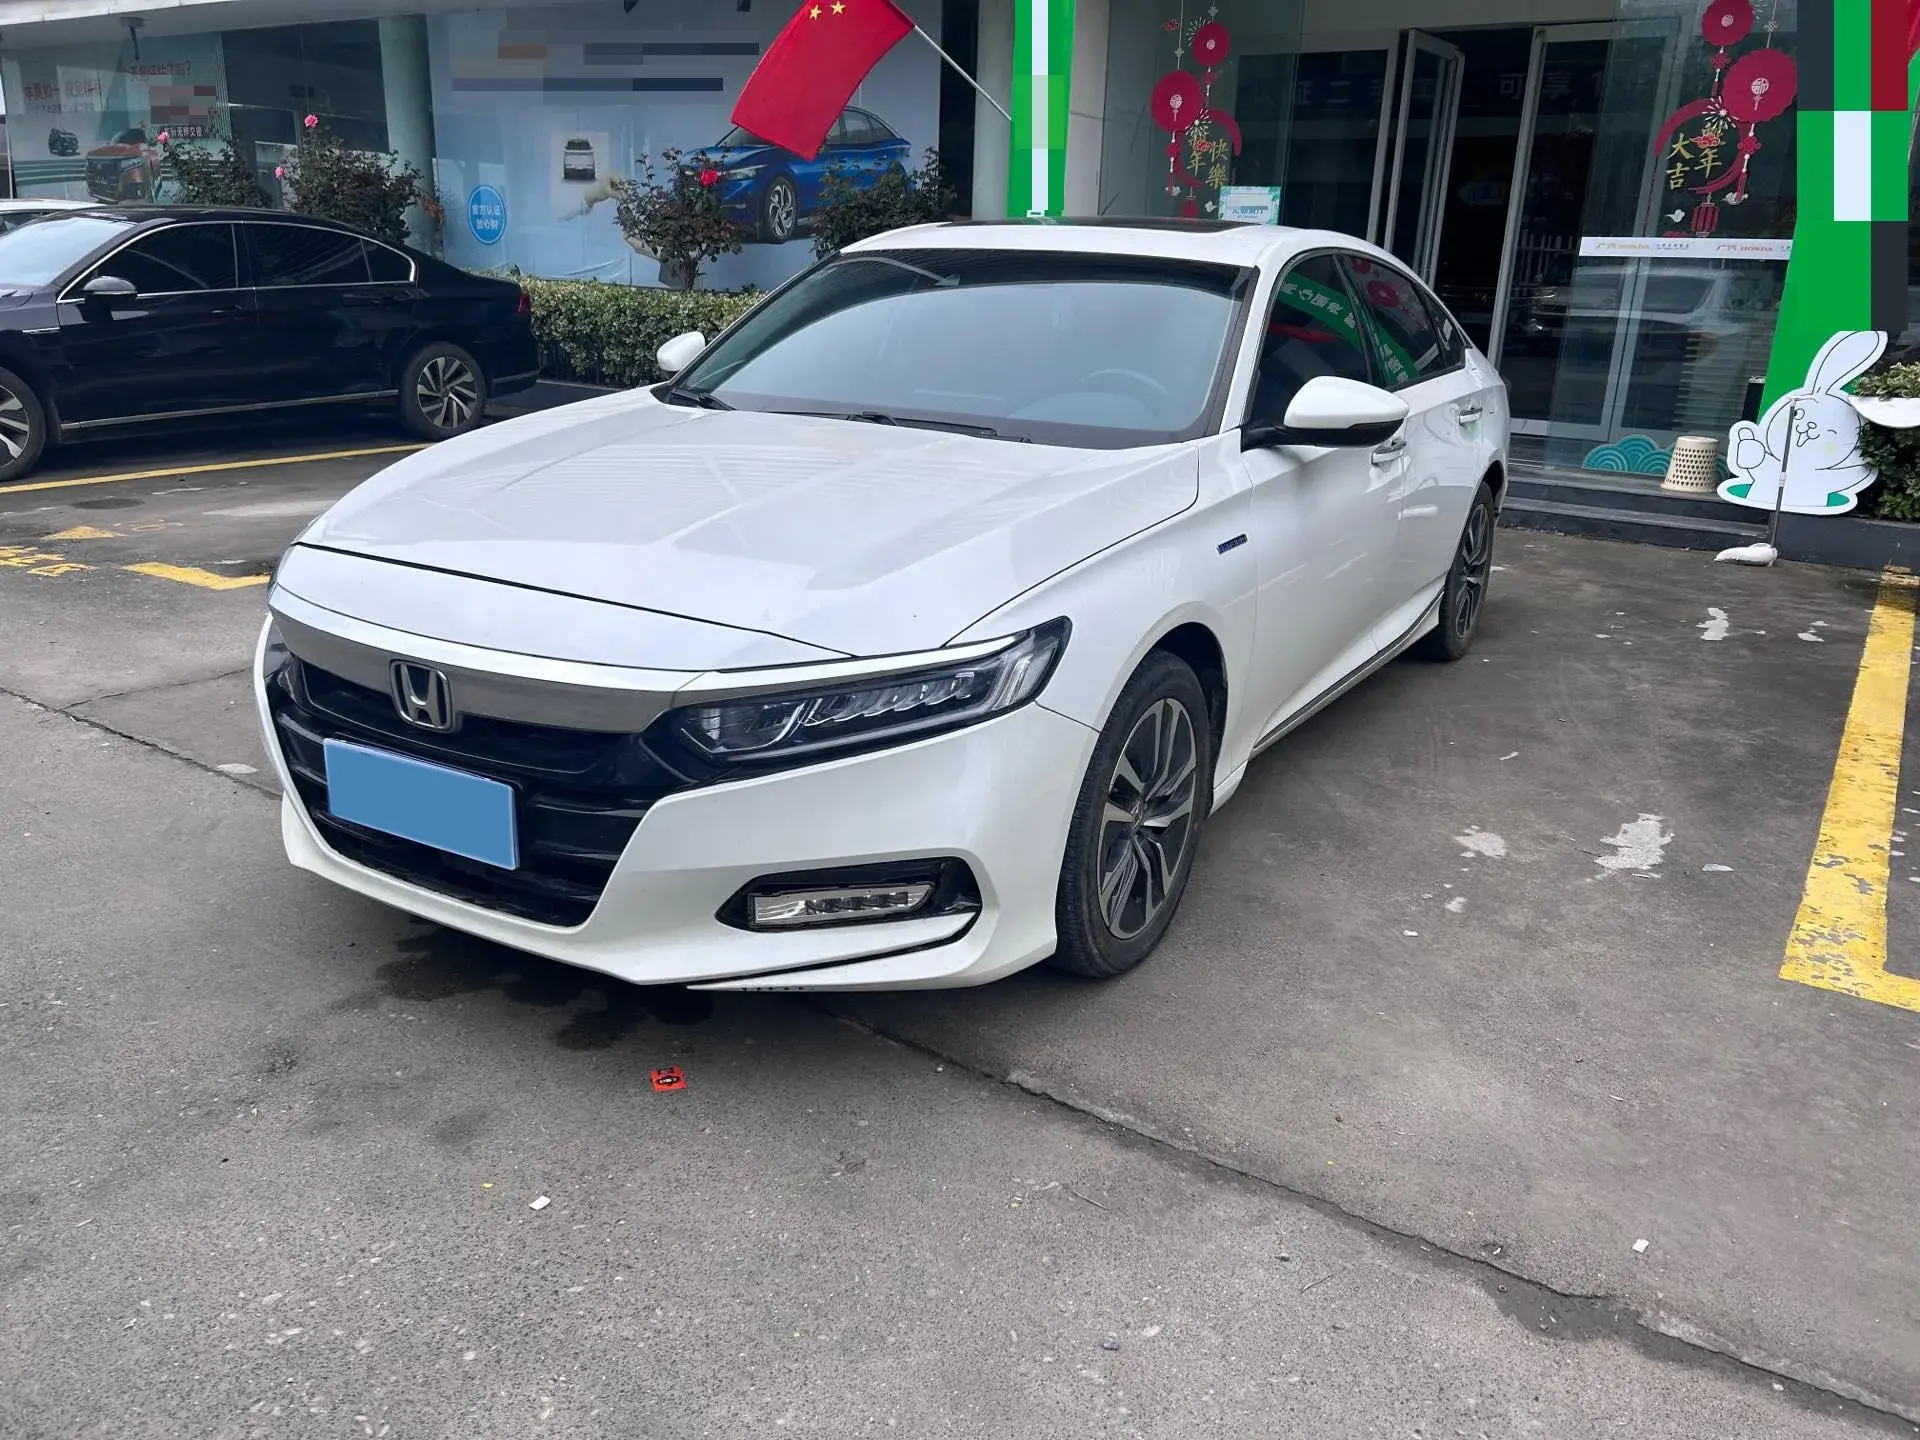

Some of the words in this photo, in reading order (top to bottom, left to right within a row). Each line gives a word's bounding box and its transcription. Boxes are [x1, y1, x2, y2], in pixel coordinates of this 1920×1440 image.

[1665, 132, 1695, 190] 大吉
[472, 205, 502, 216] 官方认证
[1740, 244, 1773, 253] HONDA
